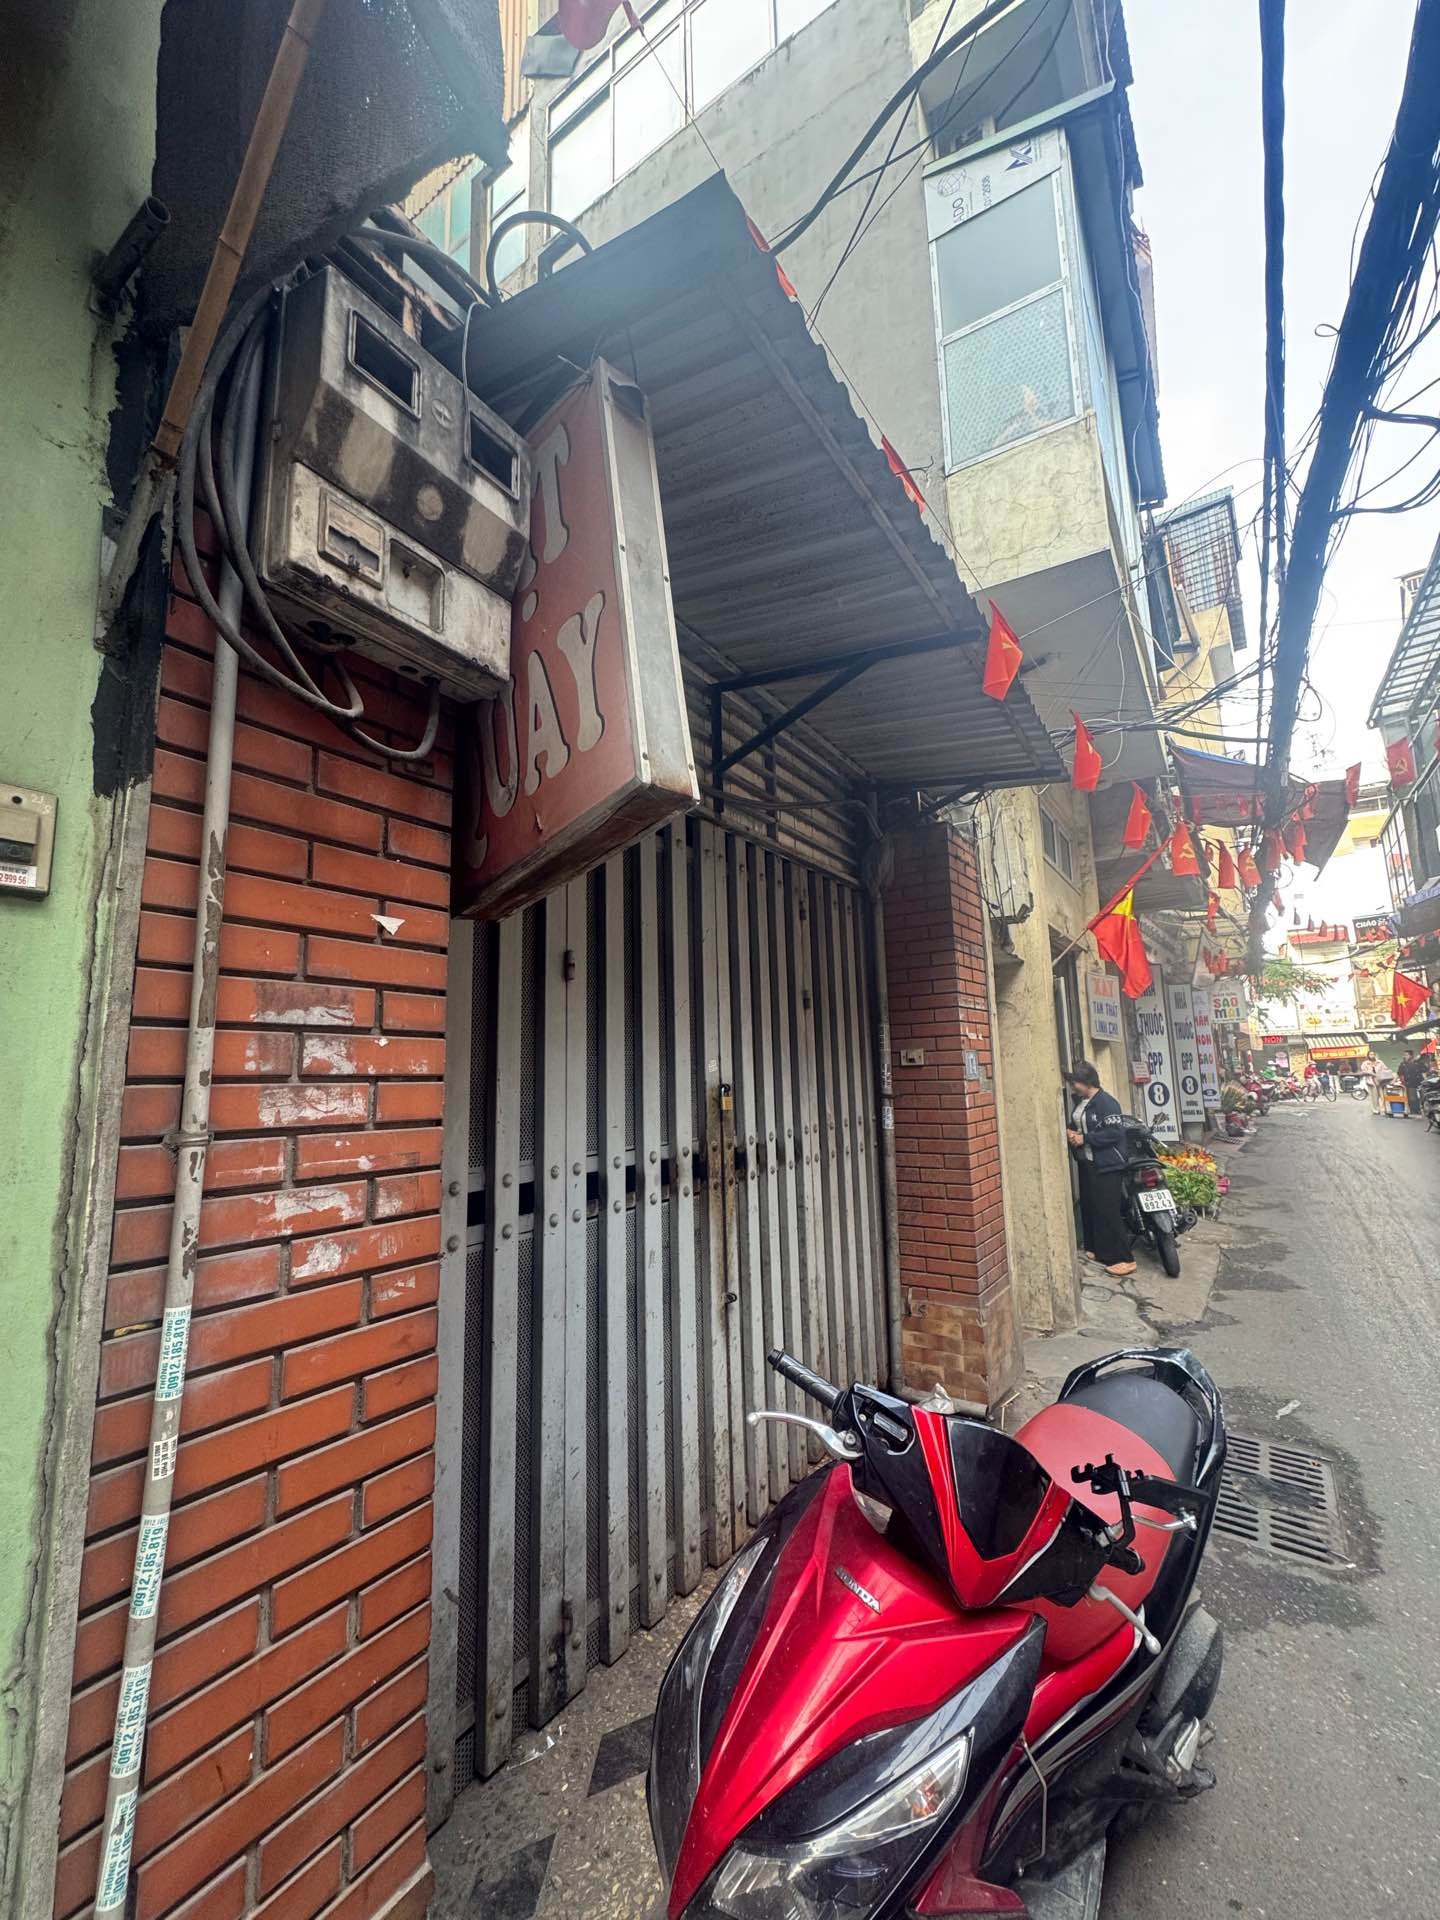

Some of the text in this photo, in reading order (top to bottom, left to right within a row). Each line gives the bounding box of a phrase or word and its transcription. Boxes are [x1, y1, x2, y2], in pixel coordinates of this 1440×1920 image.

[1213, 996, 1238, 1009] SAO
[1147, 1052, 1163, 1075] GPP
[1181, 1052, 1194, 1071] GPP
[166, 1317, 187, 1390] 0912.185.819
[133, 1526, 164, 1606] 0912.185.819
[117, 1676, 147, 1765] 0912.185.819
